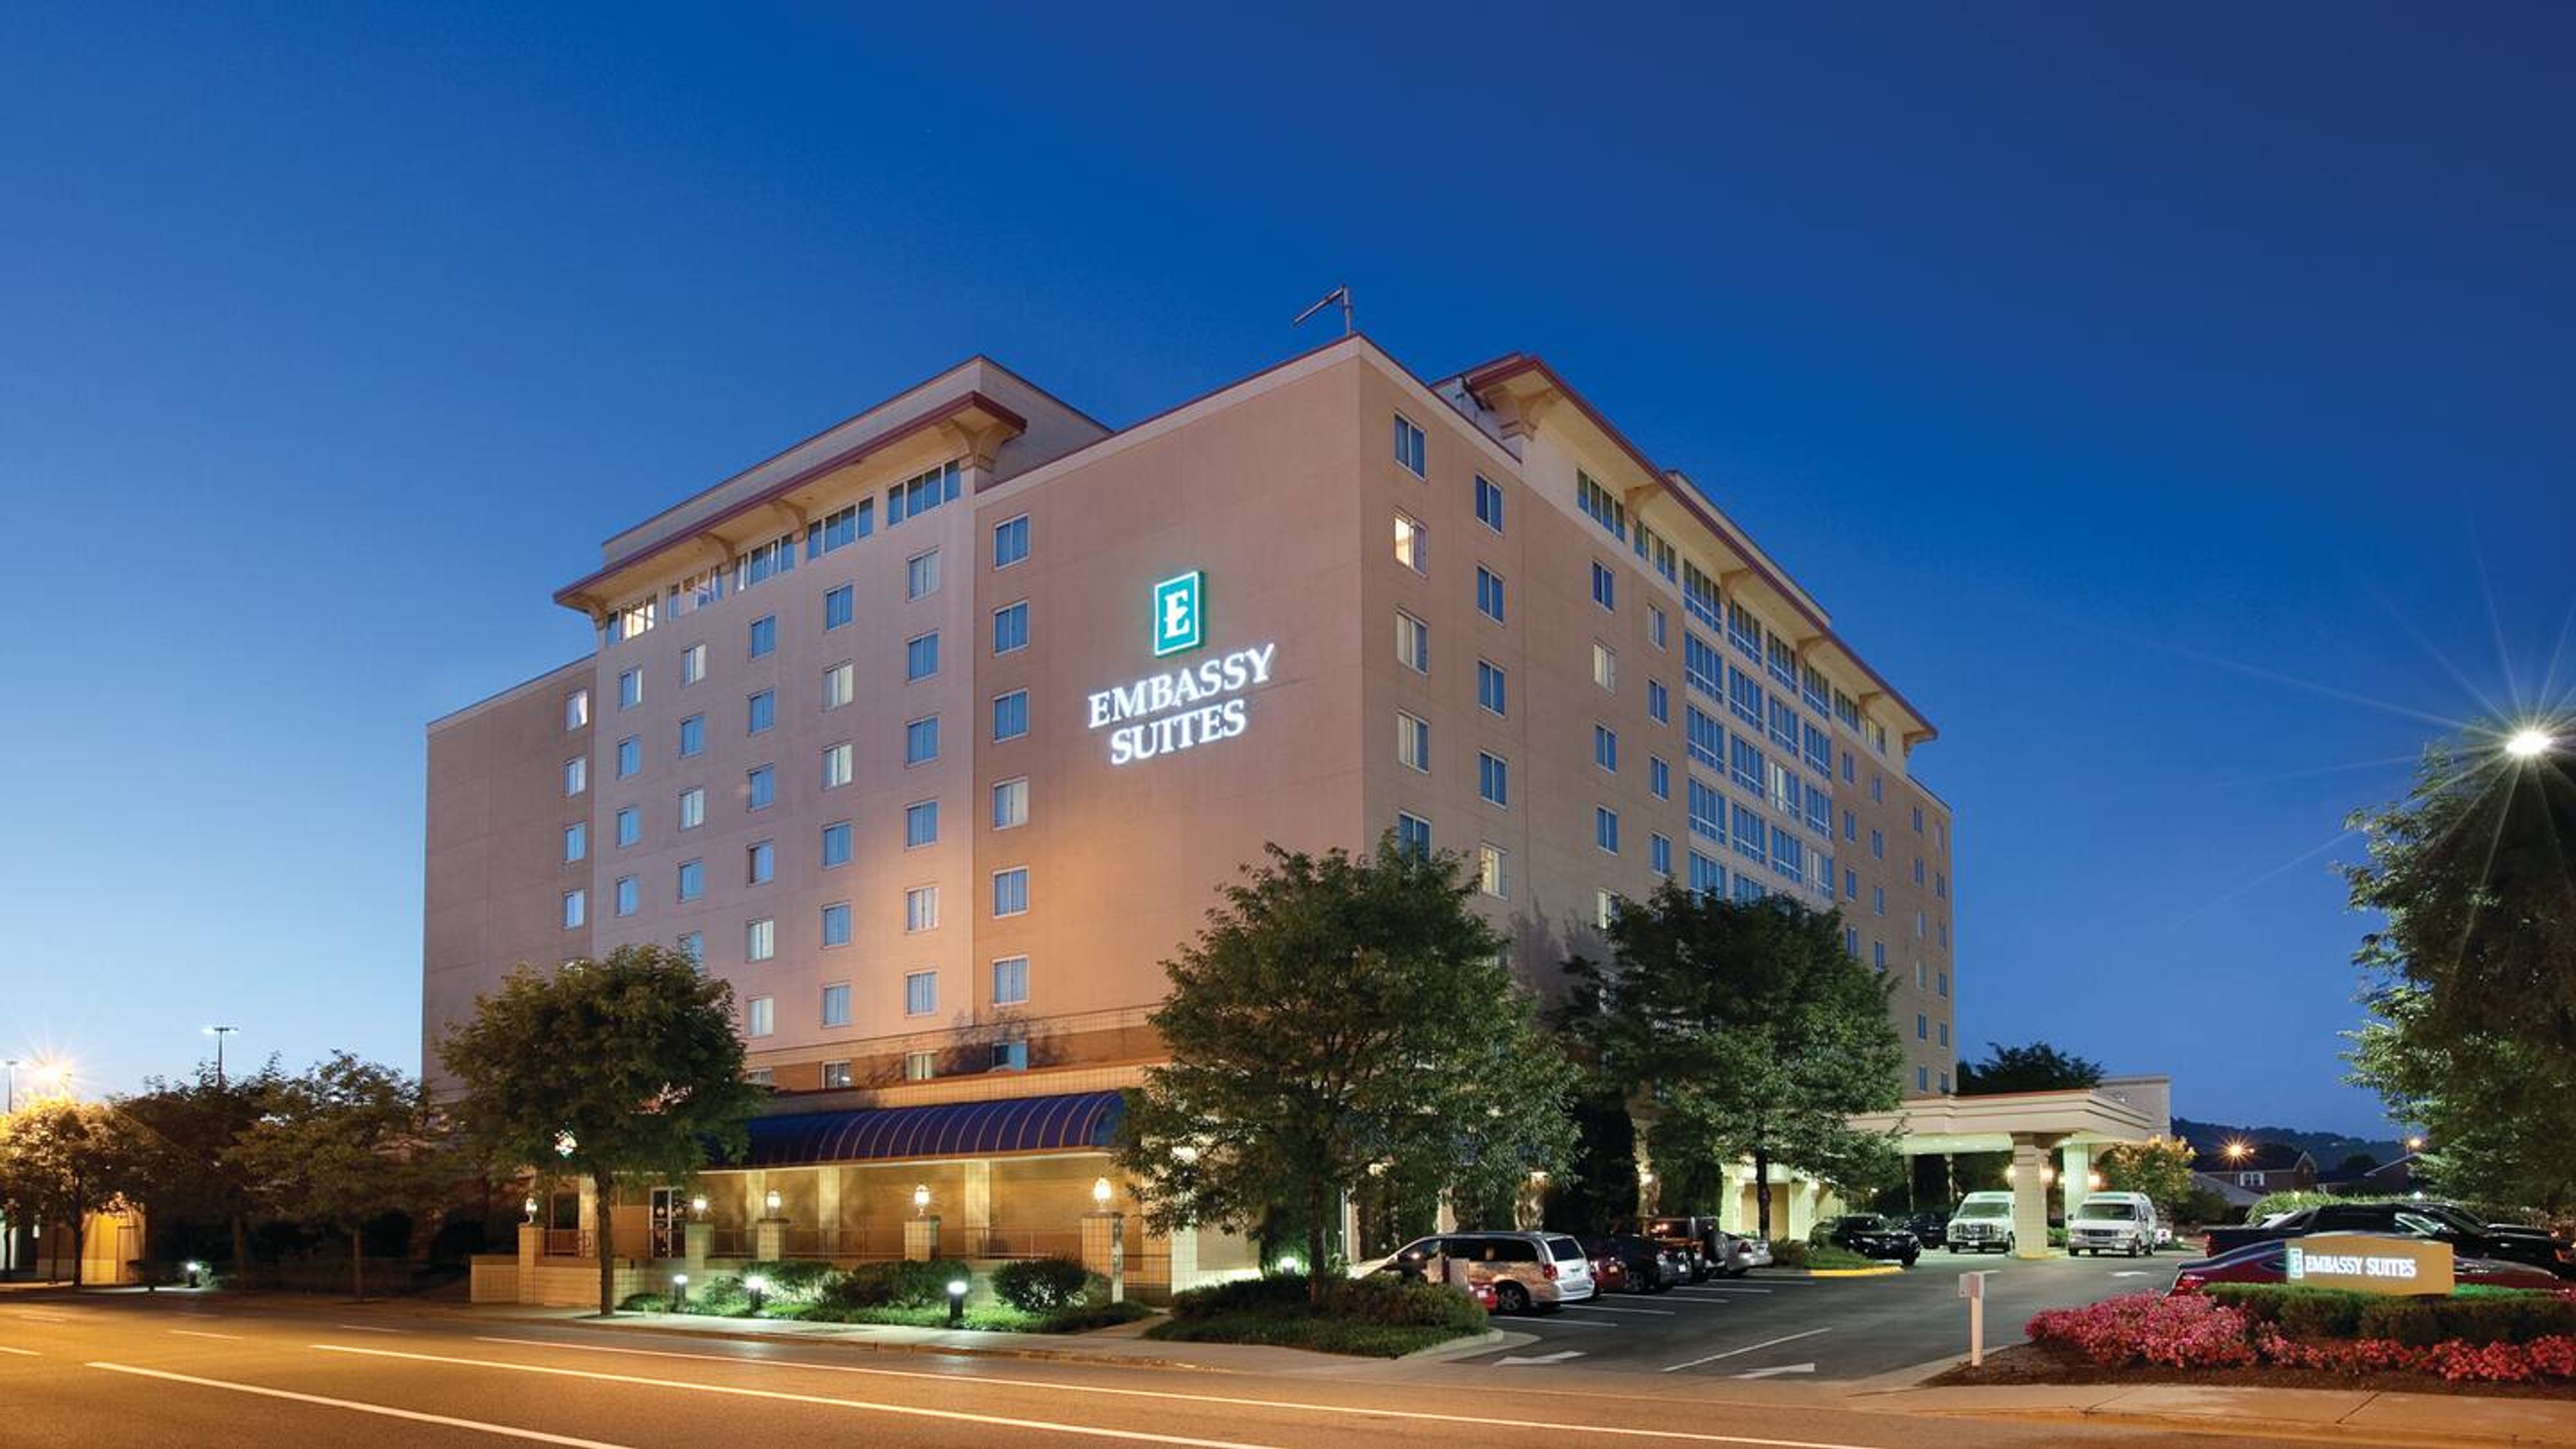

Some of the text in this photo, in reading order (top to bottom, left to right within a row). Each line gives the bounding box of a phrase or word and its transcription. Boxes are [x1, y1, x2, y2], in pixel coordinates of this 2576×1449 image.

[1164, 589, 1191, 639] E
[1087, 643, 1275, 729] EMBASSY
[1111, 699, 1246, 765] SUITES
[2304, 1255, 2364, 1275] EMBASSY
[2366, 1258, 2416, 1277] SUITES
